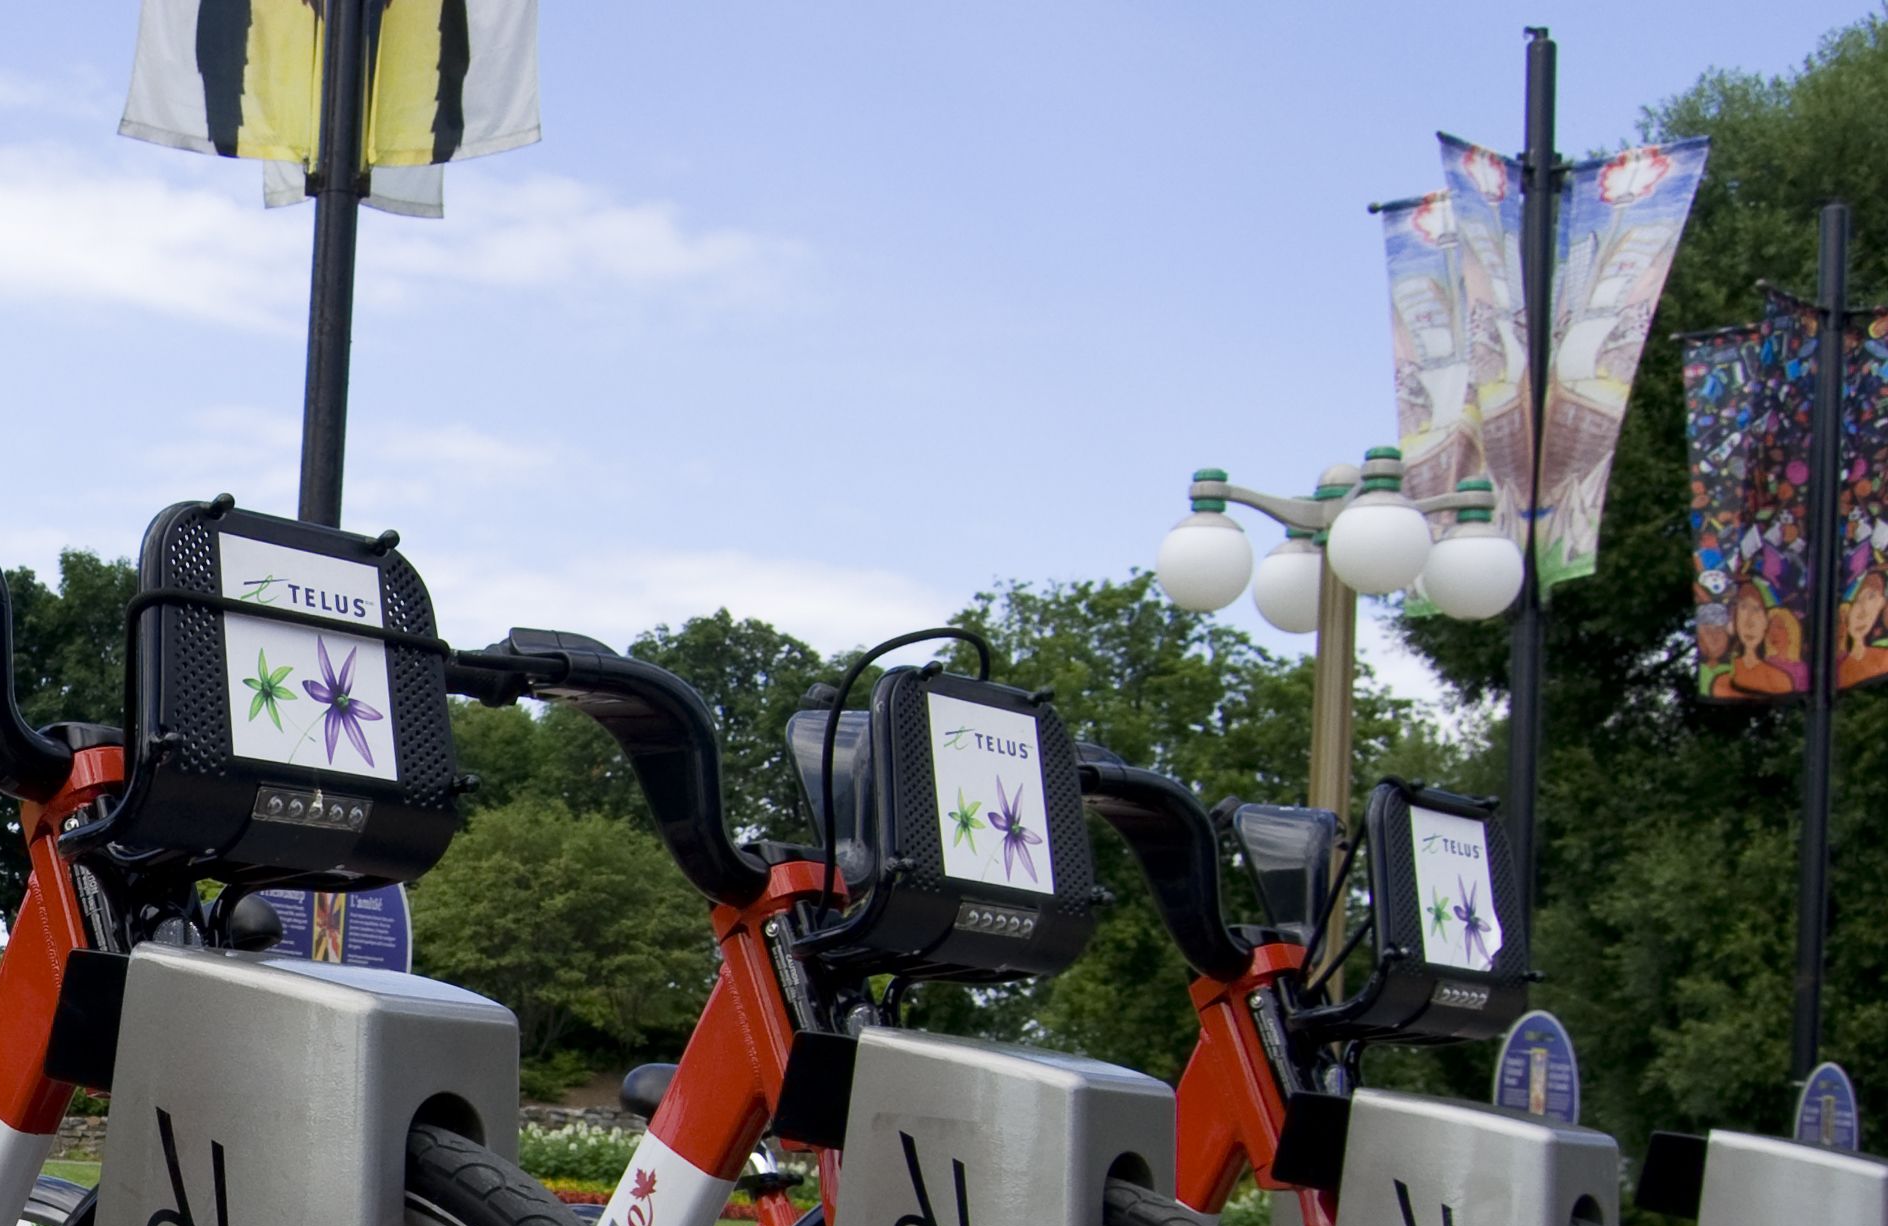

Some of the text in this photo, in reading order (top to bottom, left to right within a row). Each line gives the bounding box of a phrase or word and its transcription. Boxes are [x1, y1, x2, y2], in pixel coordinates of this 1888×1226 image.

[287, 583, 366, 618] TELUS
[974, 731, 1029, 760] TELUS
[1441, 836, 1481, 860] TELUS
